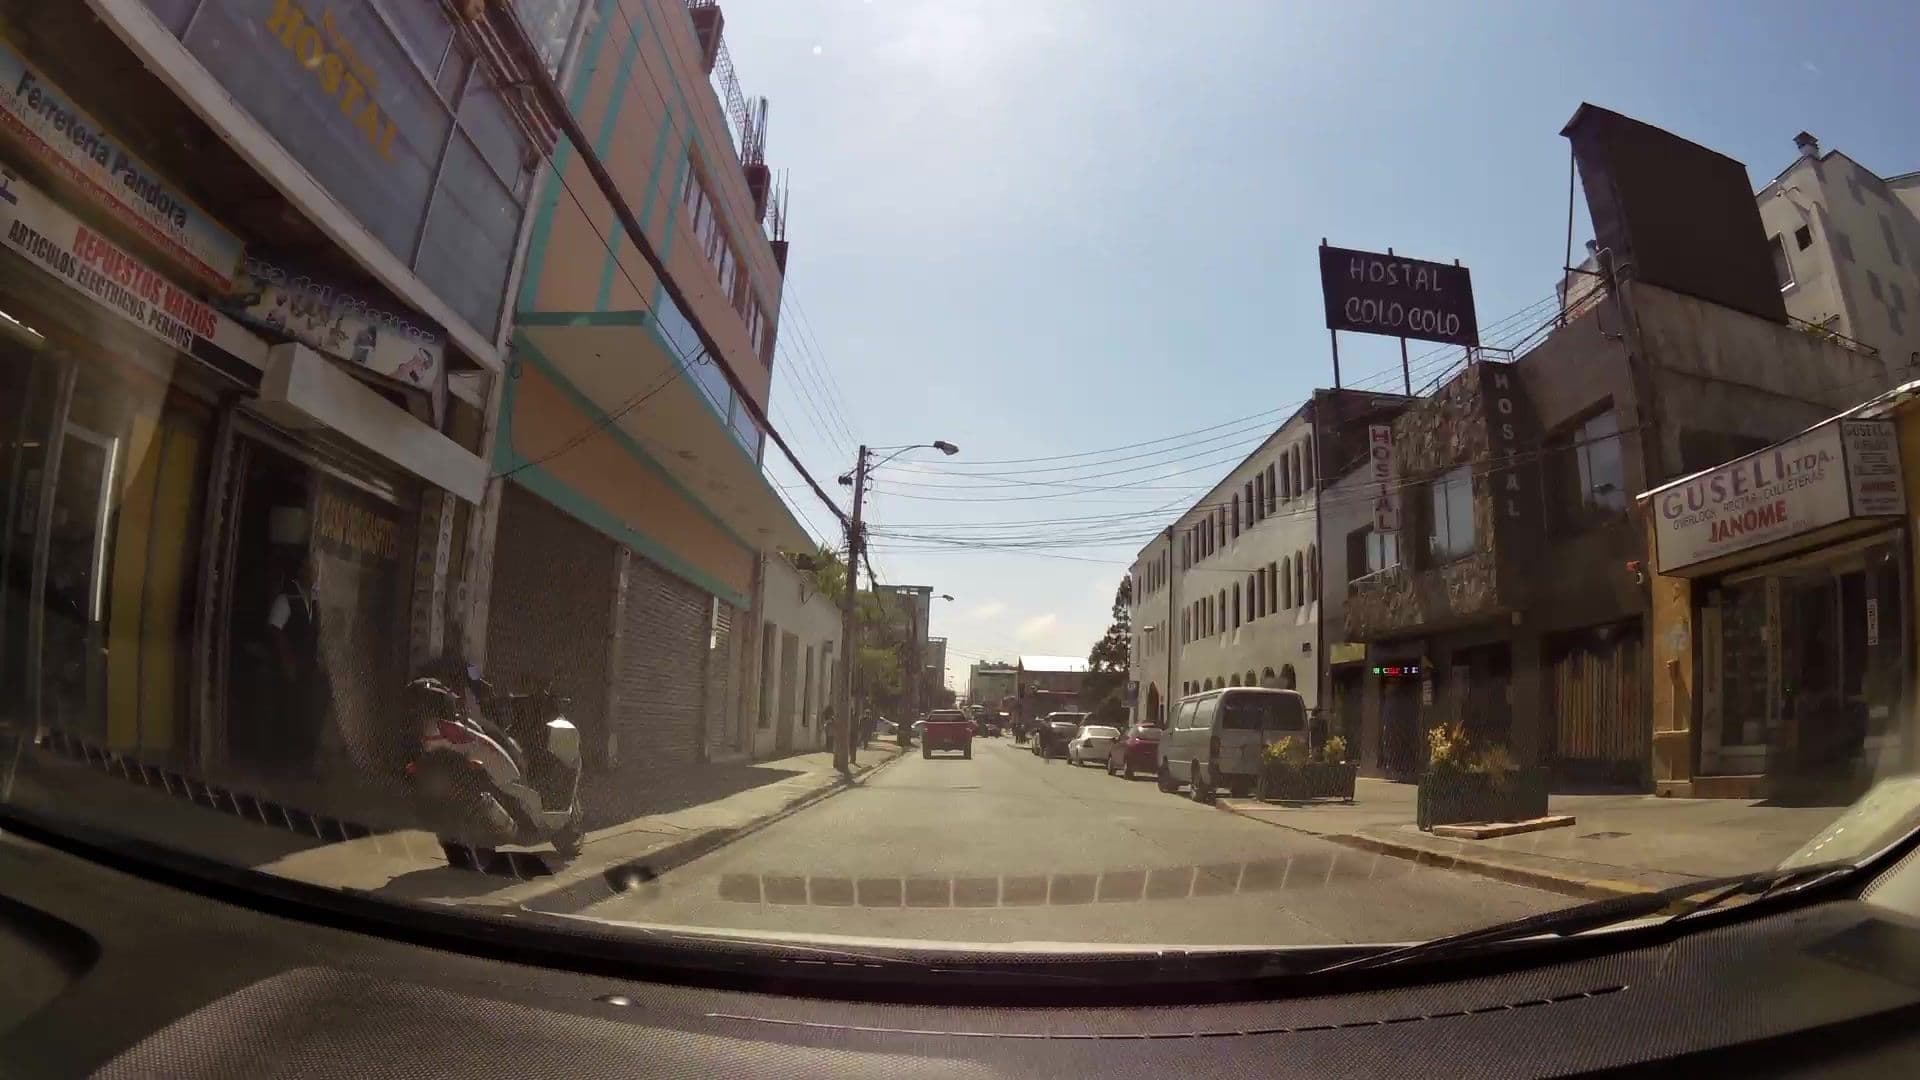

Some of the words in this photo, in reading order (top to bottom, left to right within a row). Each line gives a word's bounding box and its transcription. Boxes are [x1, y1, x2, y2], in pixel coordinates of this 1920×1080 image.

[265, 0, 398, 165] HOSTAL
[112, 152, 188, 230] Pandora
[7, 218, 77, 278] ARTICULOS
[147, 307, 193, 349] PERNOS
[72, 224, 168, 300] REPUESTOS
[162, 286, 219, 340] VARIOS
[1344, 296, 1404, 328] COLO
[1408, 306, 1461, 337] COLO
[1349, 256, 1443, 293] HOSTAL
[1371, 427, 1394, 531] HOSTAL
[1494, 373, 1521, 517] HOSTAL
[1662, 450, 1785, 520] GUSELI
[1708, 499, 1788, 544] JANOME
